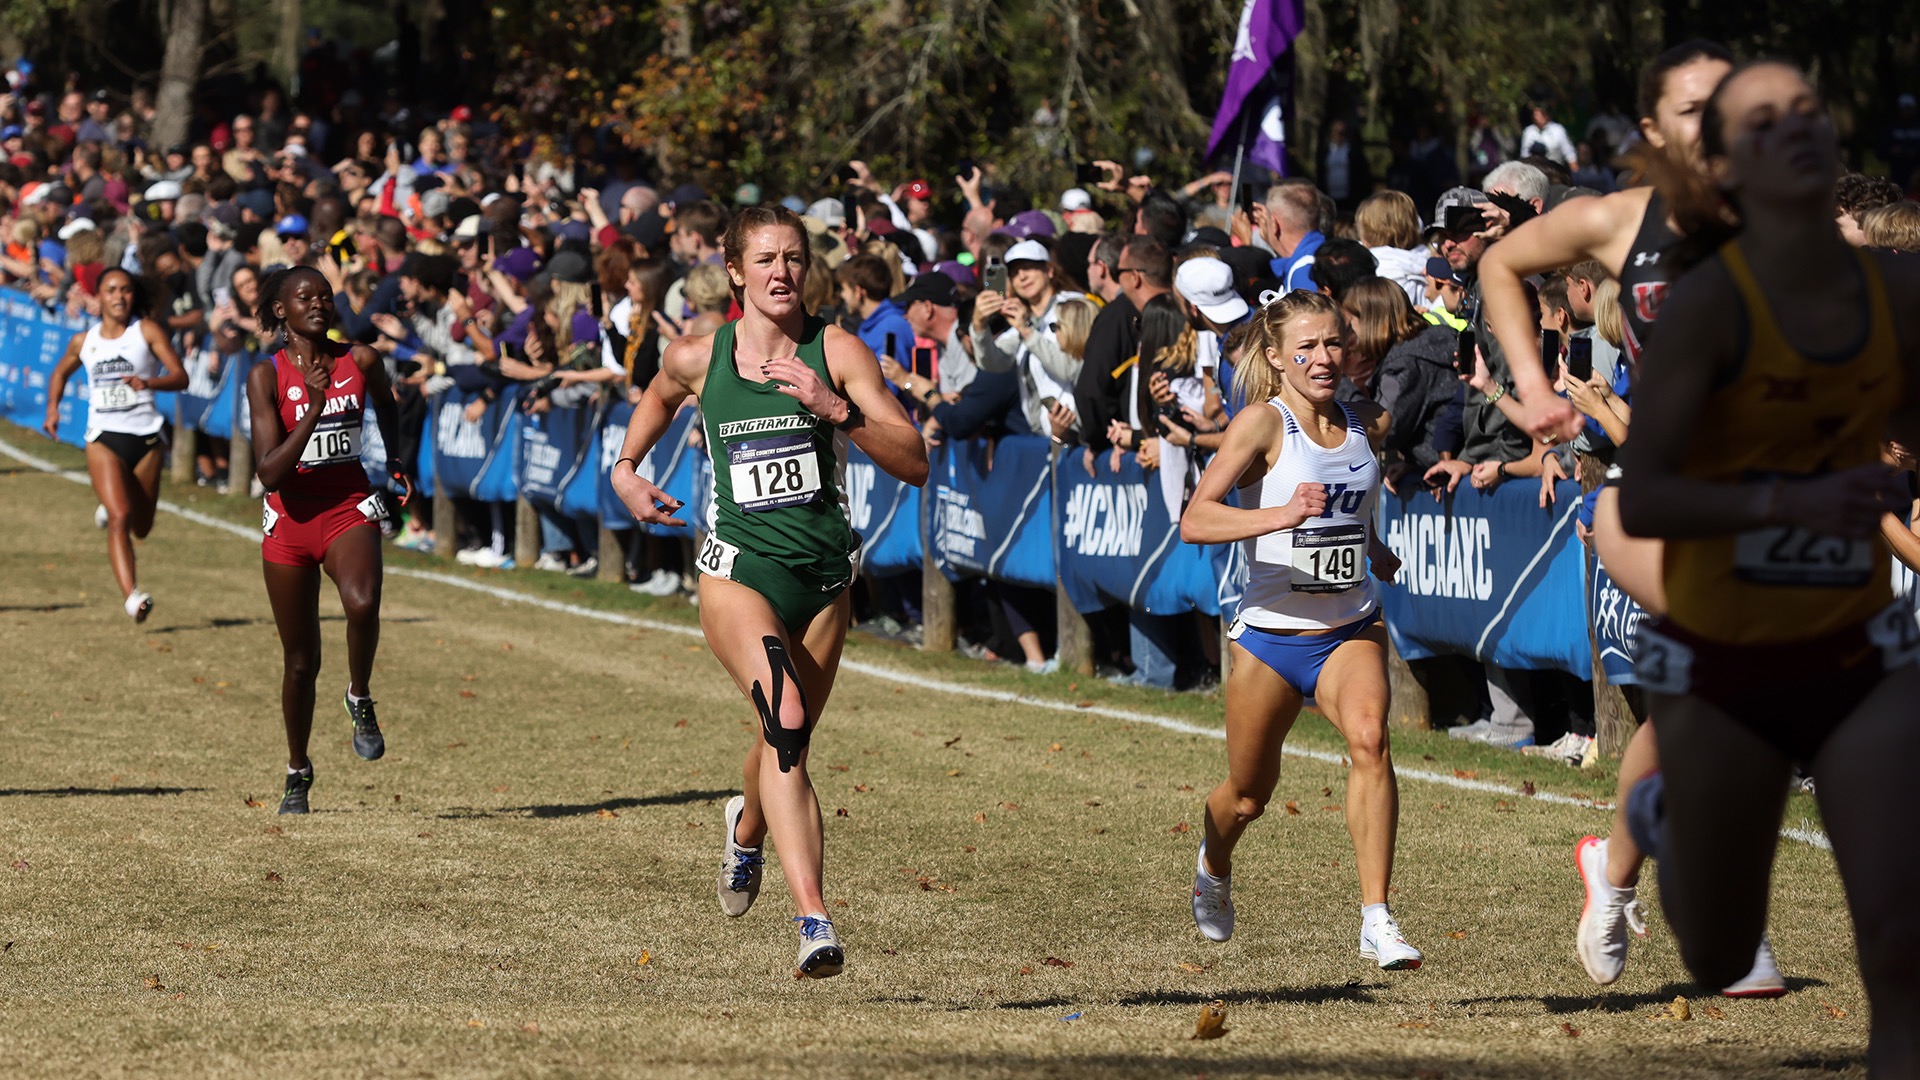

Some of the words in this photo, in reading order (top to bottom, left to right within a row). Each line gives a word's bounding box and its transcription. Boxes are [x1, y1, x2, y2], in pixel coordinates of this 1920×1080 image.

[102, 387, 128, 405] 159
[295, 394, 360, 421] ABAMA
[721, 415, 819, 436] BINGHAMTON
[313, 431, 352, 458] 106
[748, 458, 804, 498] 128
[1320, 482, 1367, 519] YU
[1309, 547, 1356, 581] 149
[1387, 513, 1493, 601] #NCAAXC
